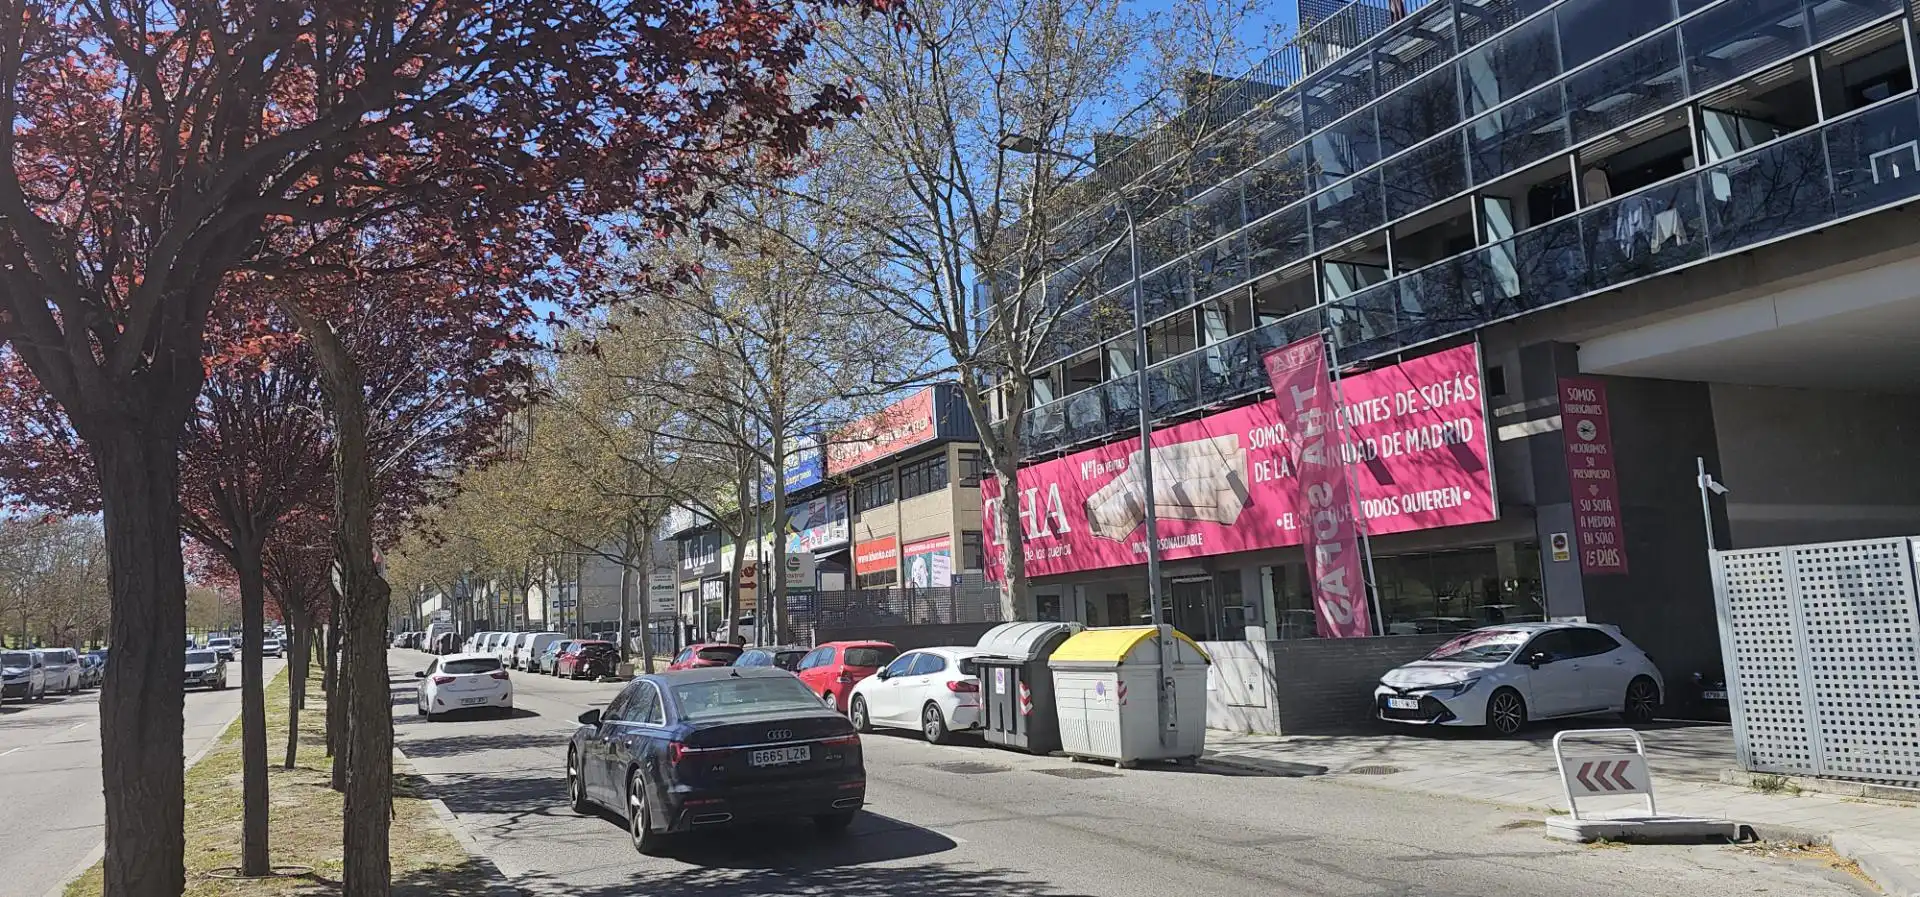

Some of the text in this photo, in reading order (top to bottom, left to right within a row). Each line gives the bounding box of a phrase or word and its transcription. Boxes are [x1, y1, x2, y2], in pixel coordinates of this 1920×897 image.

[1396, 389, 1418, 416] DE
[1421, 371, 1477, 411] SOFÁS
[1567, 387, 1597, 402] SOMOS
[1254, 460, 1271, 483] DE
[1273, 456, 1290, 479] LA
[1382, 430, 1403, 458] DE
[1406, 417, 1473, 454] MADRID
[1569, 443, 1607, 454] MEJORAMOS
[1097, 462, 1105, 475] EN
[1105, 457, 1125, 473] VENTAS
[1585, 456, 1595, 467] SU
[1402, 485, 1462, 513] QUIEREN
[1580, 496, 1612, 512] SU SOFÁ
[1580, 515, 1616, 528] A MEDIDA
[1583, 528, 1614, 545] EN SÓLO
[1585, 550, 1596, 566] 15
[1596, 545, 1620, 566] DÍAS
[755, 748, 807, 764] 6665 LZR
